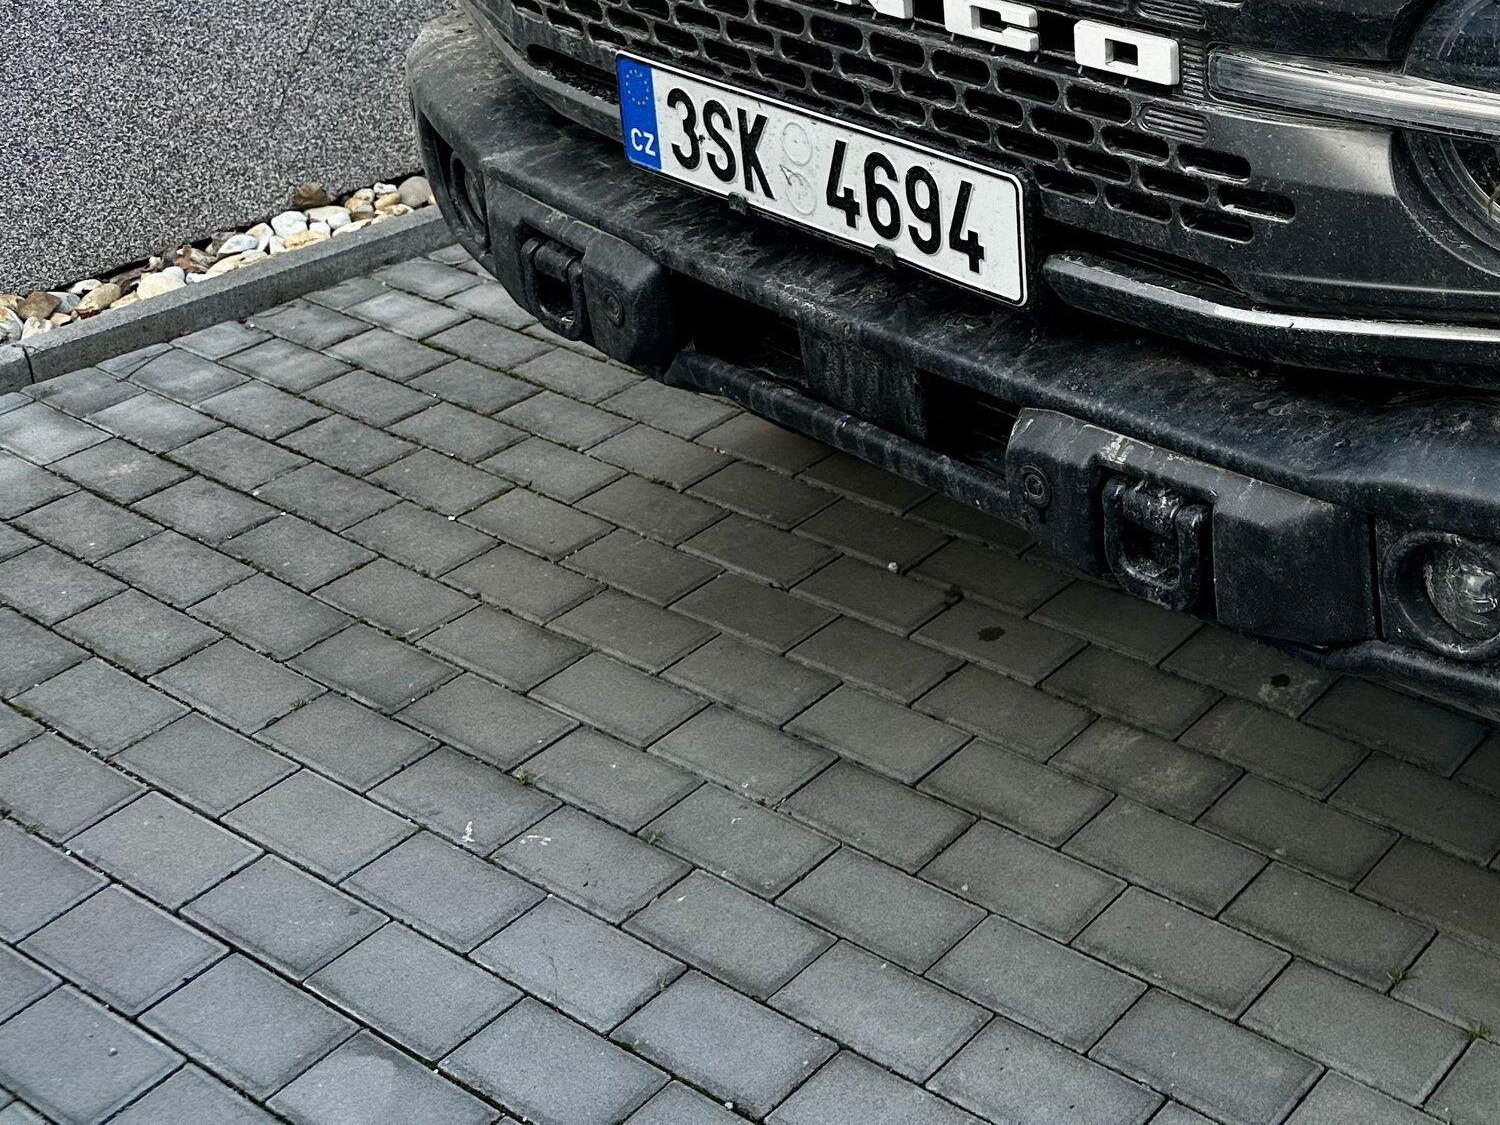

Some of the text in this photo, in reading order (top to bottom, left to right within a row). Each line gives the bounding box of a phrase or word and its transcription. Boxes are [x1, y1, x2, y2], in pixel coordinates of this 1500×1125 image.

[630, 128, 657, 157] CZ
[667, 87, 986, 274] 3SK 4694
